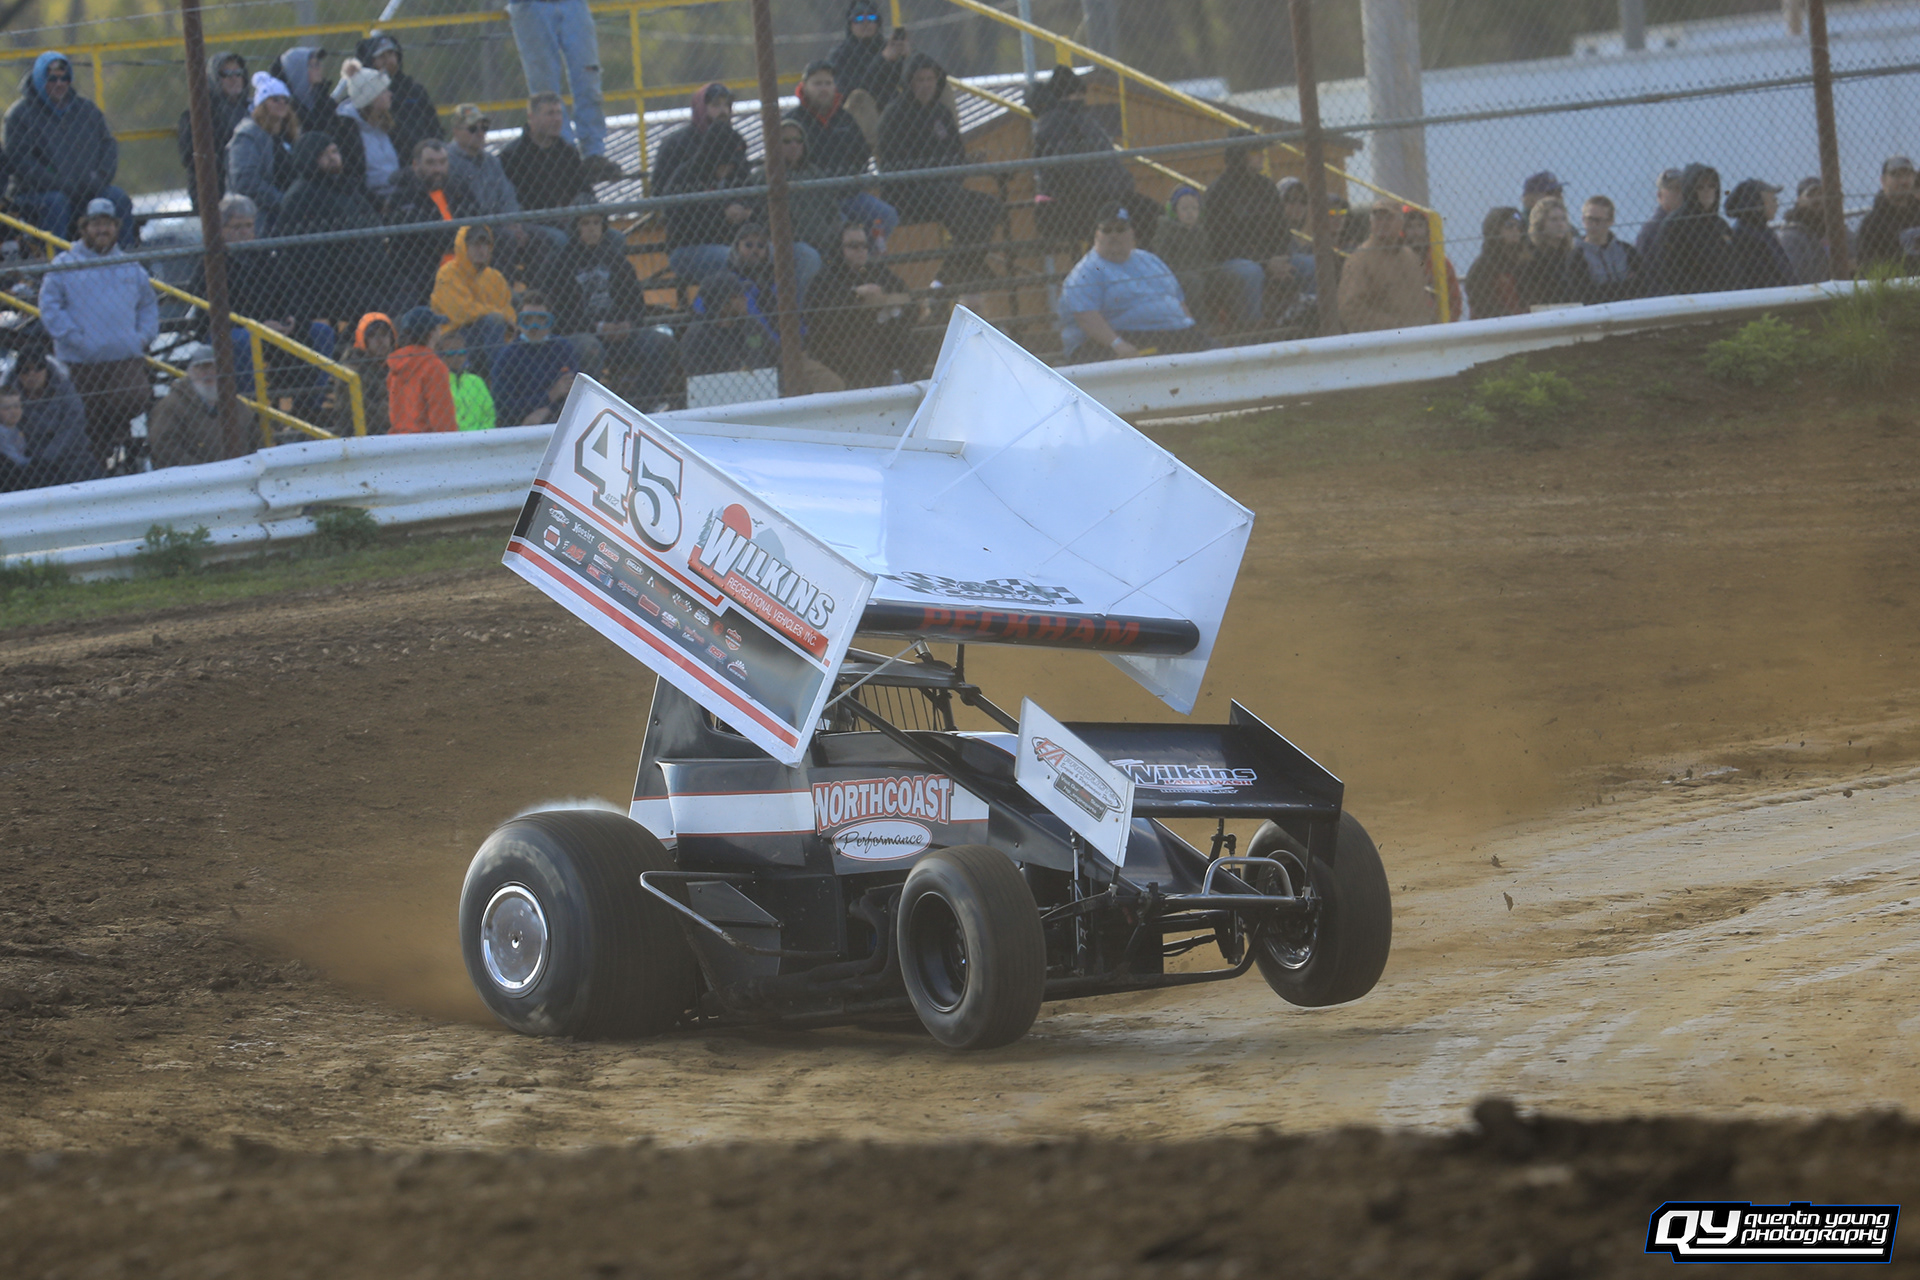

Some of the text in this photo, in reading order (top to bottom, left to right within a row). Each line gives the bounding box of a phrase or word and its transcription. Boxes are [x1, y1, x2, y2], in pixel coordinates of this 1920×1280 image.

[575, 408, 683, 553] 45
[699, 517, 835, 630] WILKINS
[726, 576, 772, 616] RECREATIONAL
[773, 609, 804, 637] VEHICLES,
[803, 631, 817, 646] INC.
[917, 607, 1140, 647] PECKHAM
[1110, 759, 1257, 785] Wilkins
[814, 777, 951, 831] NORTHCOAST
[839, 831, 924, 854] Performance
